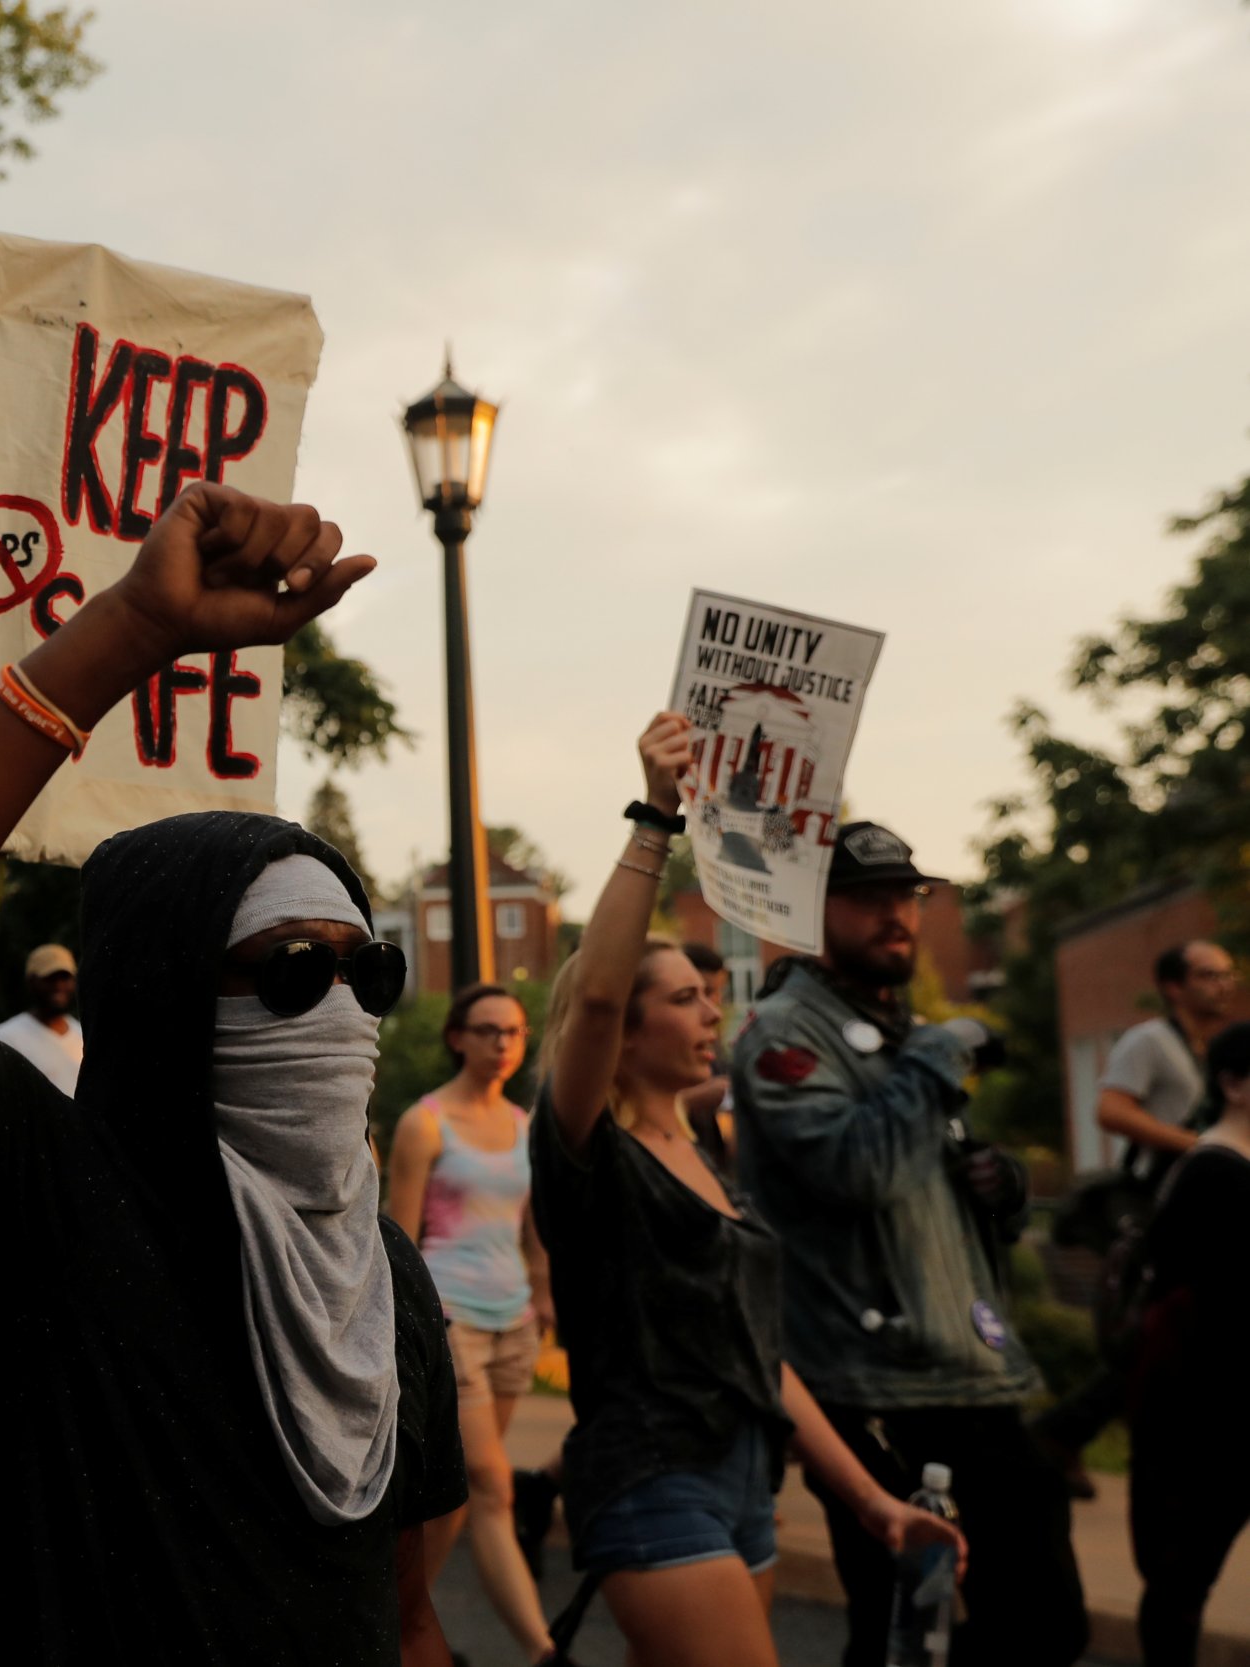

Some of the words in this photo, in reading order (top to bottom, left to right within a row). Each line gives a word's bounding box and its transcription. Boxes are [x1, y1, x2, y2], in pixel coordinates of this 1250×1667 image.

[61, 321, 268, 542] KEEP
[702, 607, 740, 645] NO
[745, 617, 823, 664] UNITY
[698, 645, 779, 687] WITHOUT
[782, 664, 853, 703] JUSTICE
